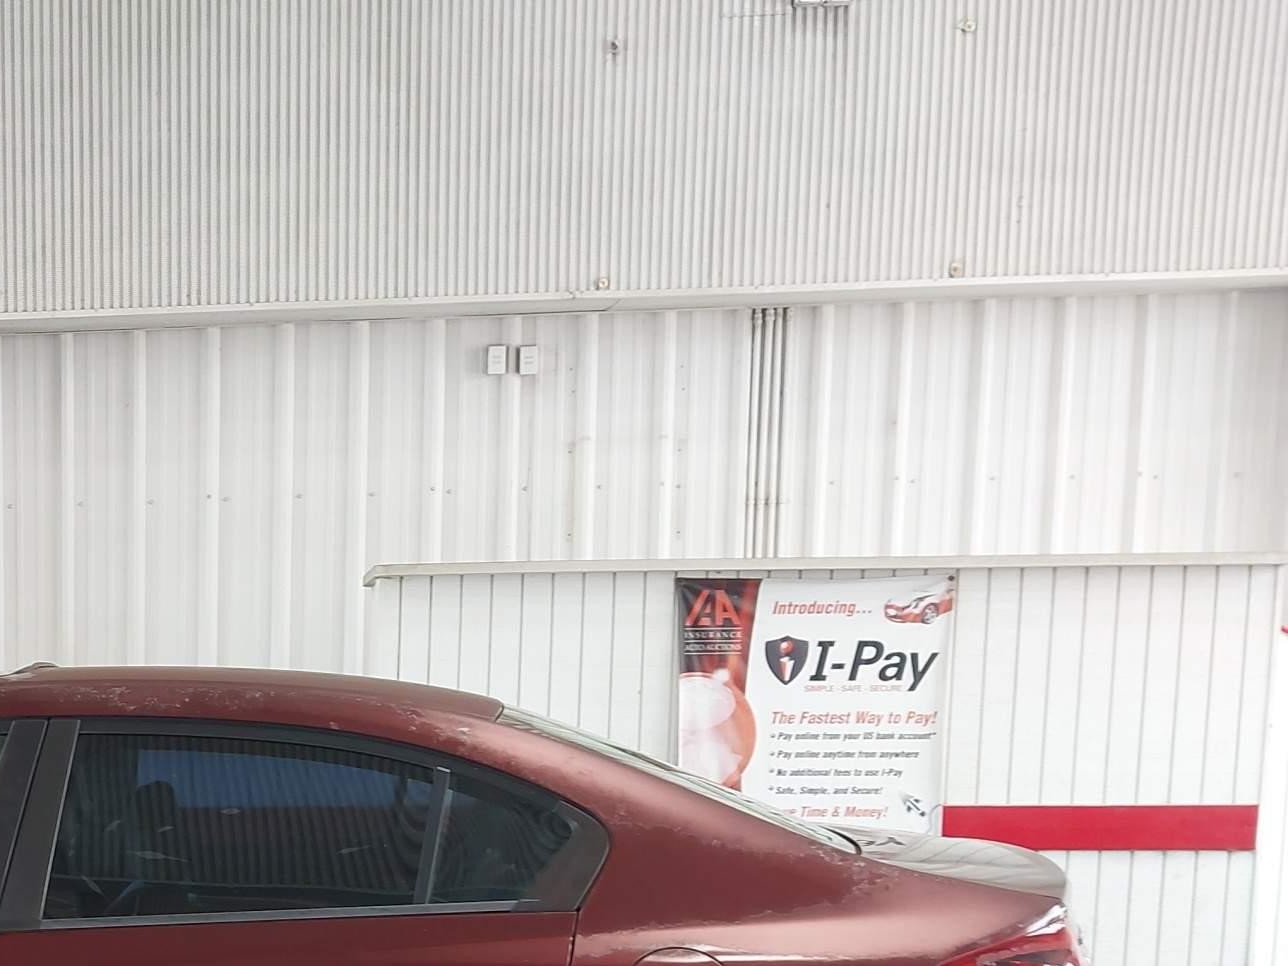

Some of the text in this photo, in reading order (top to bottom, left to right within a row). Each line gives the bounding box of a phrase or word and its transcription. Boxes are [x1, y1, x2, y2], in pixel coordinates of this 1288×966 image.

[772, 600, 872, 617] Introducing...
[684, 631, 742, 639] INSURANCE
[809, 640, 940, 692] I-Pay
[772, 711, 938, 727] The Fastest Way to Pay!
[777, 732, 793, 741] Pay
[776, 750, 793, 760] Pay
[801, 806, 828, 817] Time
[843, 806, 889, 819] Money!
